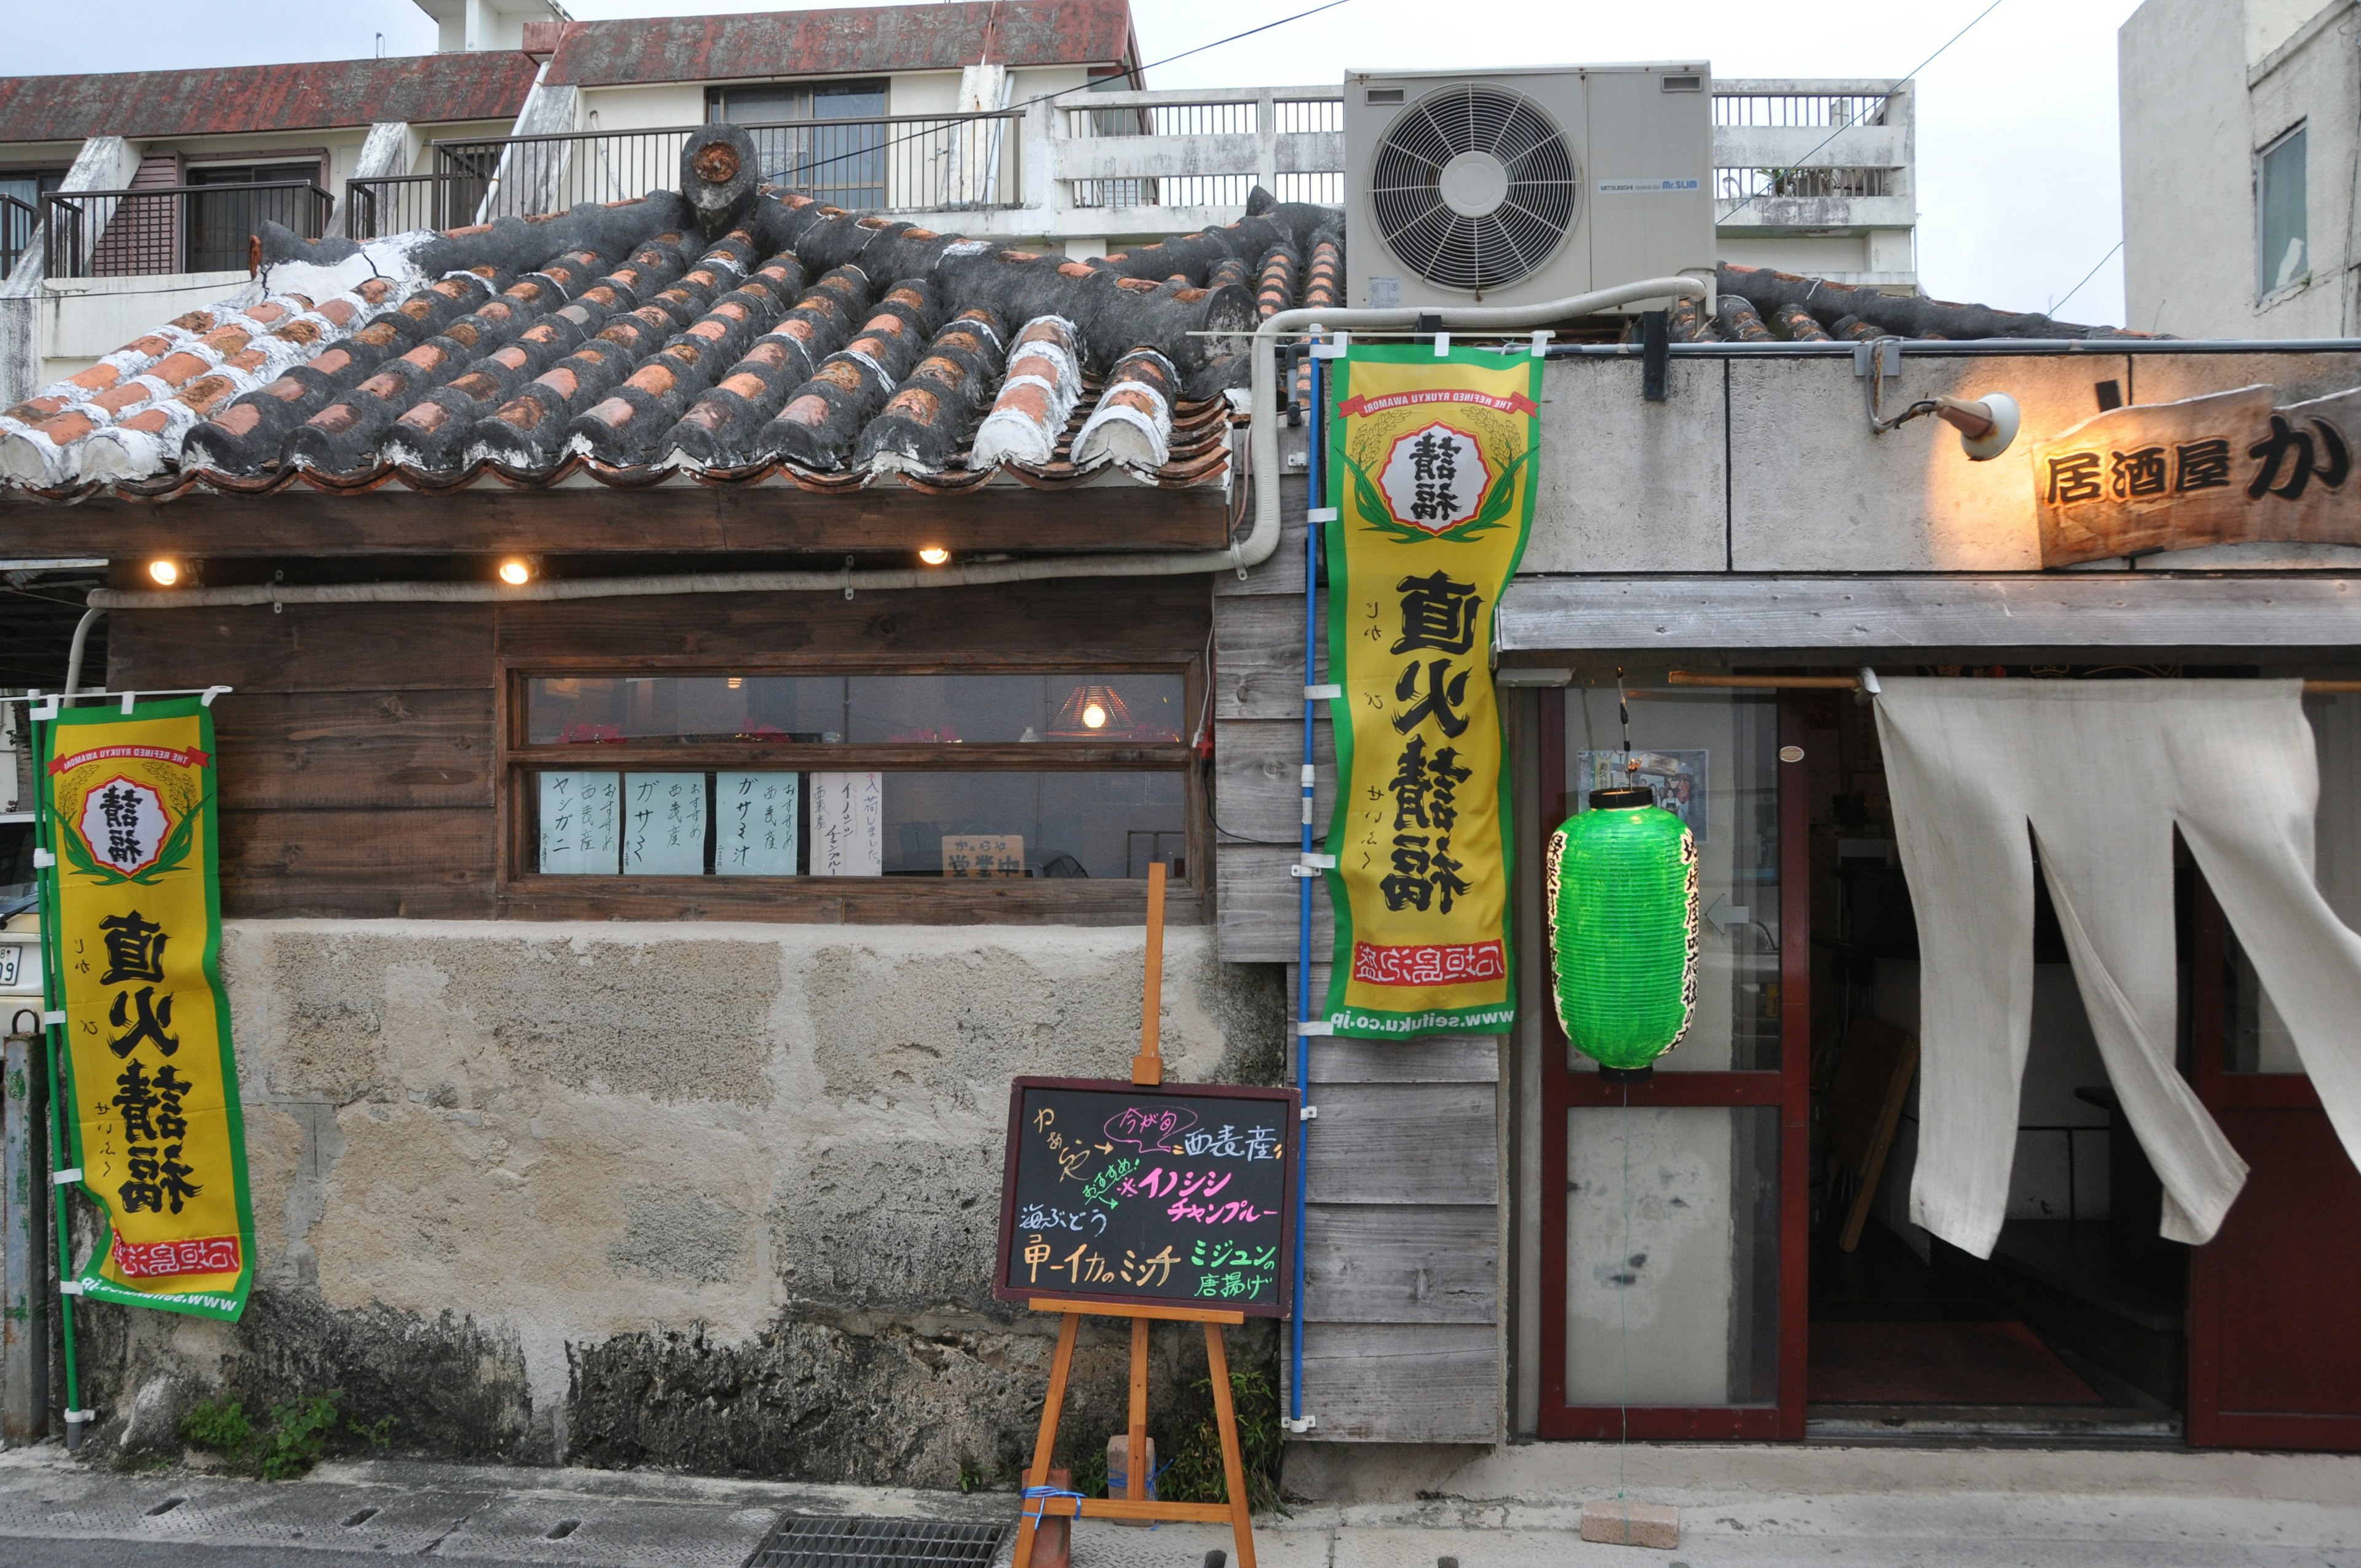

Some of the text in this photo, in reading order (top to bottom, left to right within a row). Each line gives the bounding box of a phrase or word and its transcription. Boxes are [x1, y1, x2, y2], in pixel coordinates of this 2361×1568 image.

[1663, 180, 1697, 189] Mr.SLIM
[2048, 414, 2349, 504] 居酒屋 か
[553, 778, 572, 852] ヤシガニ
[580, 783, 596, 852] 西表産
[598, 783, 616, 853] おすすめ
[634, 780, 660, 862] ガサミ
[667, 783, 682, 848] 西表産
[733, 778, 759, 866] ガサミ汁
[764, 785, 777, 850] 西表産
[813, 785, 830, 830] 西表産
[824, 825, 841, 876] チャンプルー
[948, 855, 1020, 878] 営業中
[1119, 1107, 1177, 1137] 今が旬
[1019, 1203, 1107, 1237] 海ぶどう
[1167, 1197, 1278, 1224] チャンプルー
[1194, 1271, 1273, 1300] 唐揚げ
